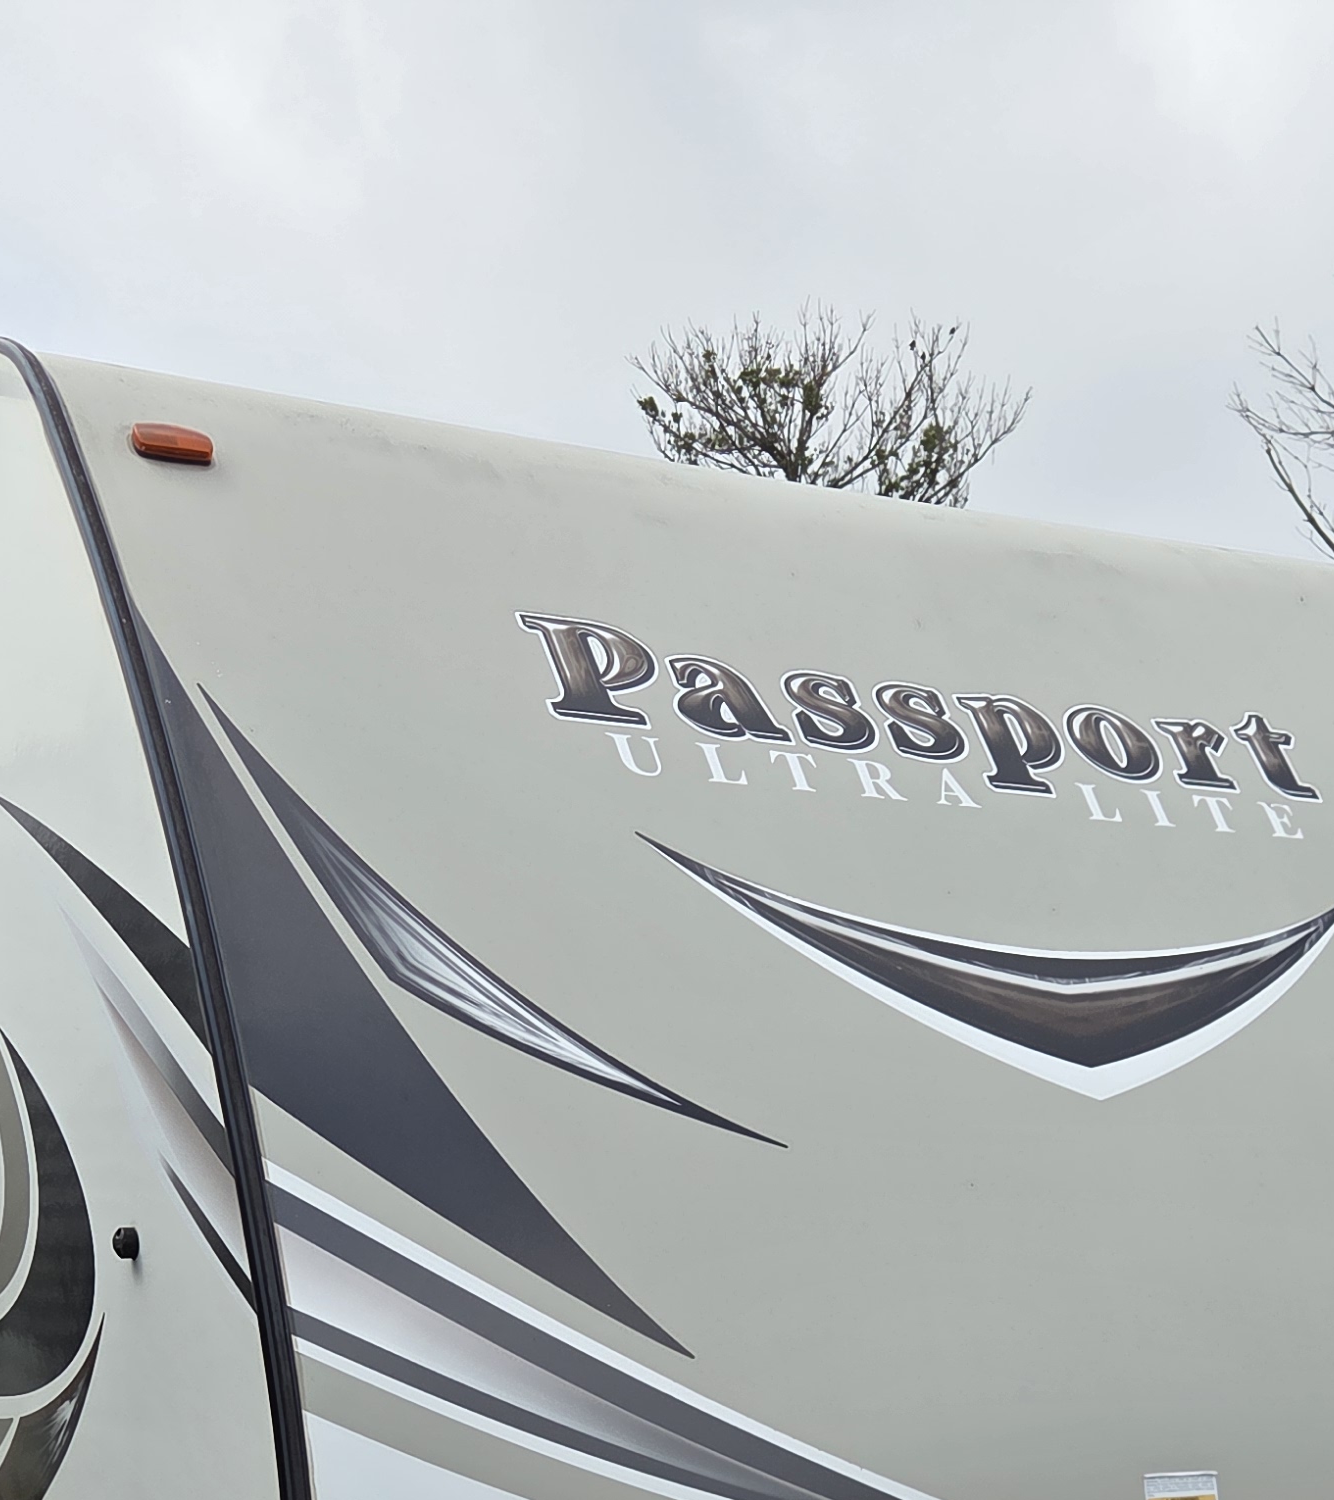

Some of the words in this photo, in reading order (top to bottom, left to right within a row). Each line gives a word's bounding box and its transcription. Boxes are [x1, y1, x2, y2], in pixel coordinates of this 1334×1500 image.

[515, 611, 1322, 802] Passport
[605, 731, 982, 809] ULTRA
[1075, 783, 1305, 839] LITE
